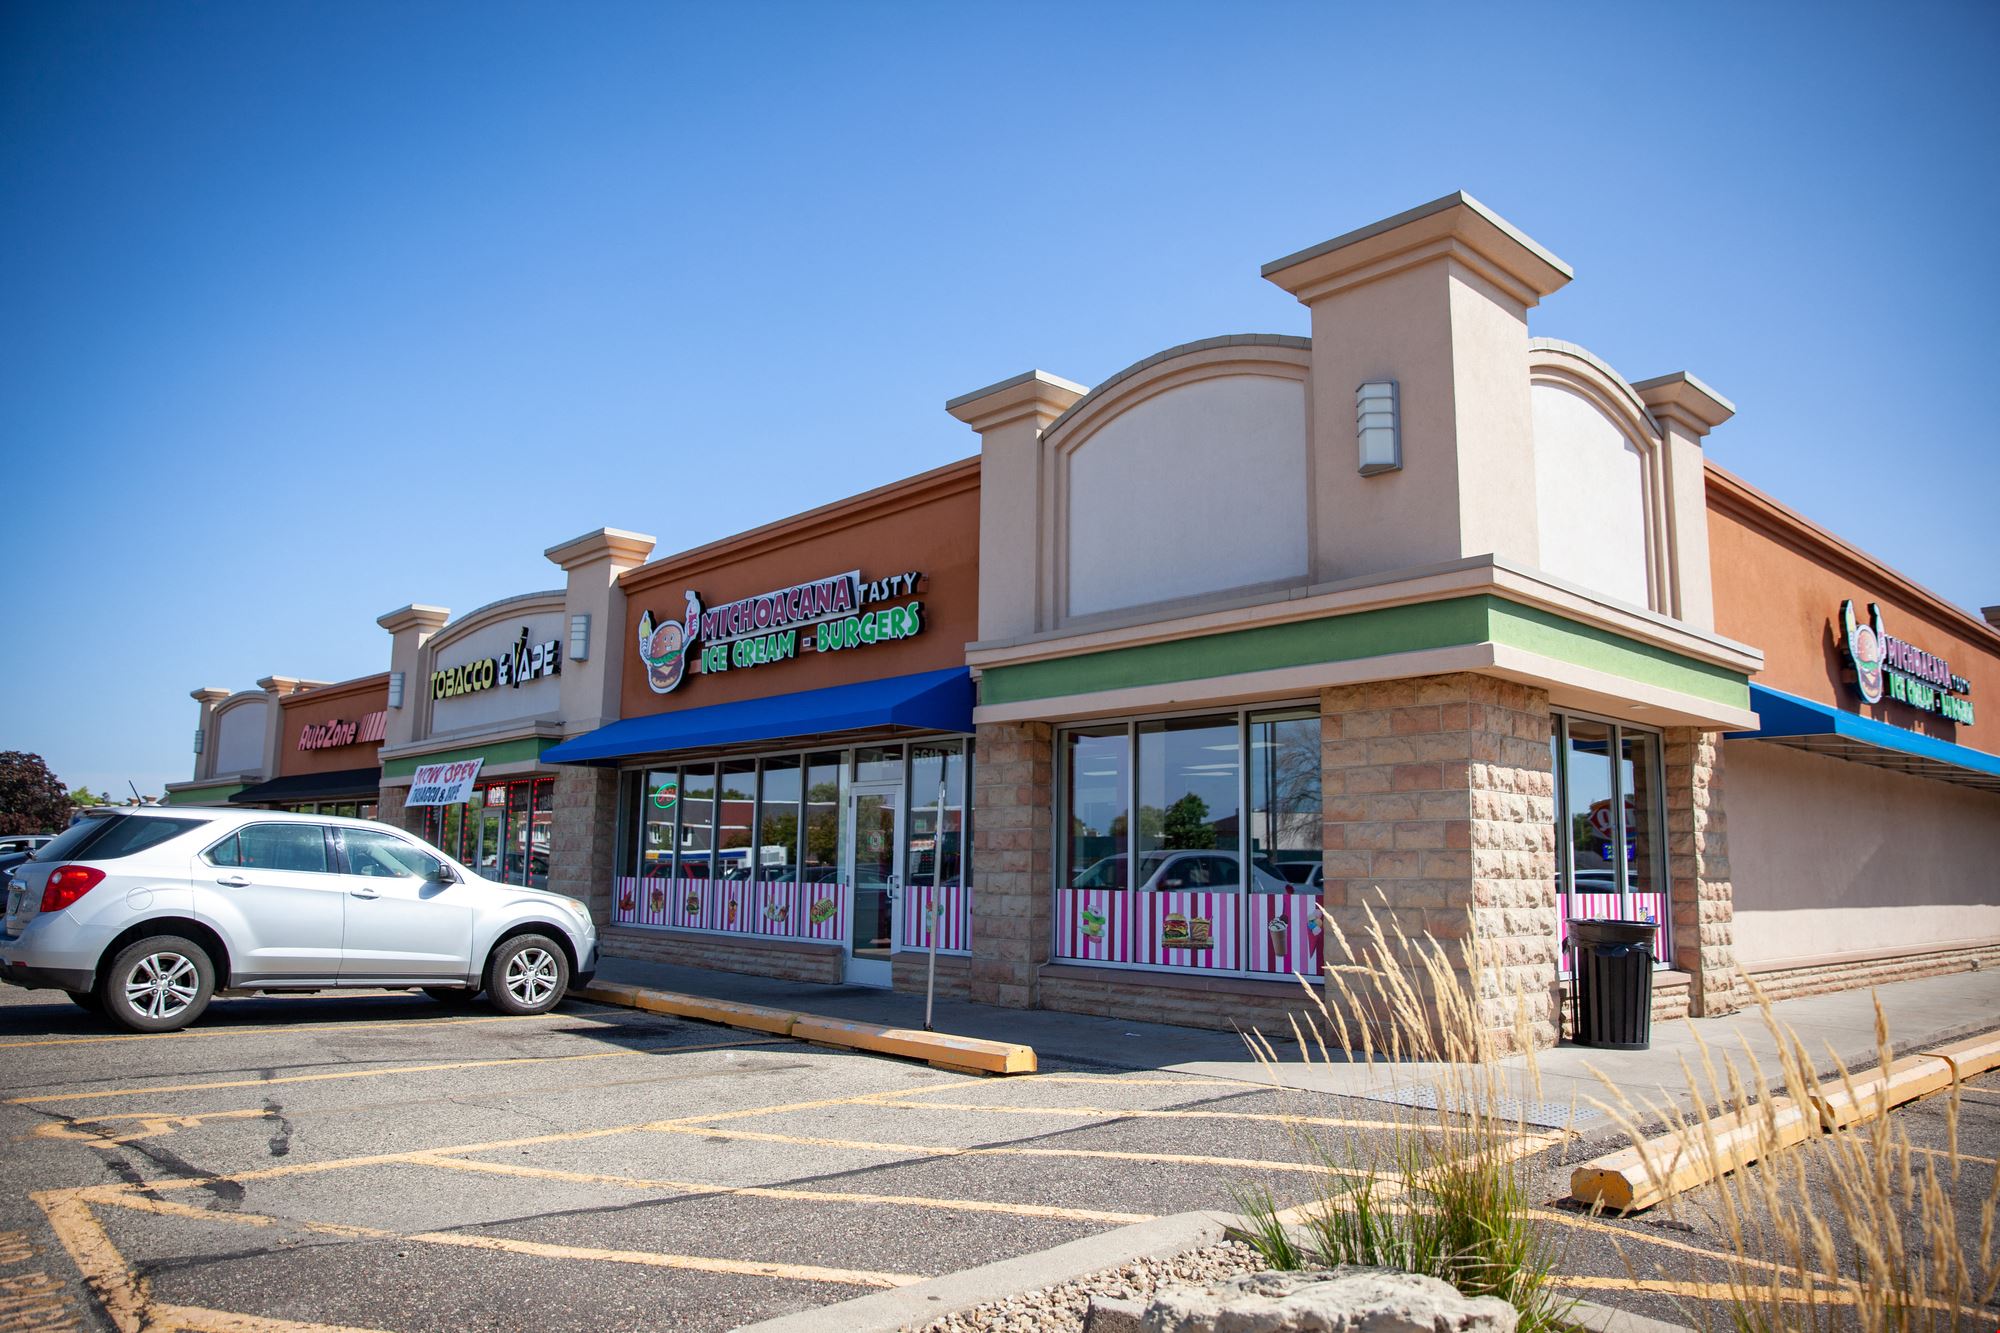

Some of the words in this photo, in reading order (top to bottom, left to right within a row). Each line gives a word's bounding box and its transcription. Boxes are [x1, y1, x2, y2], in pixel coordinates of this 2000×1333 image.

[700, 576, 851, 640] MICHOACANA
[857, 571, 919, 604] TASTY
[701, 647, 728, 675] ICE
[732, 630, 796, 668] CREAM
[816, 601, 920, 653] BURGERS
[430, 657, 495, 700] TOBACCO
[498, 653, 510, 686] &
[512, 630, 558, 688] VAPE
[297, 719, 357, 751] AutoZone
[416, 766, 445, 785] NOW
[444, 760, 480, 784] OPEN
